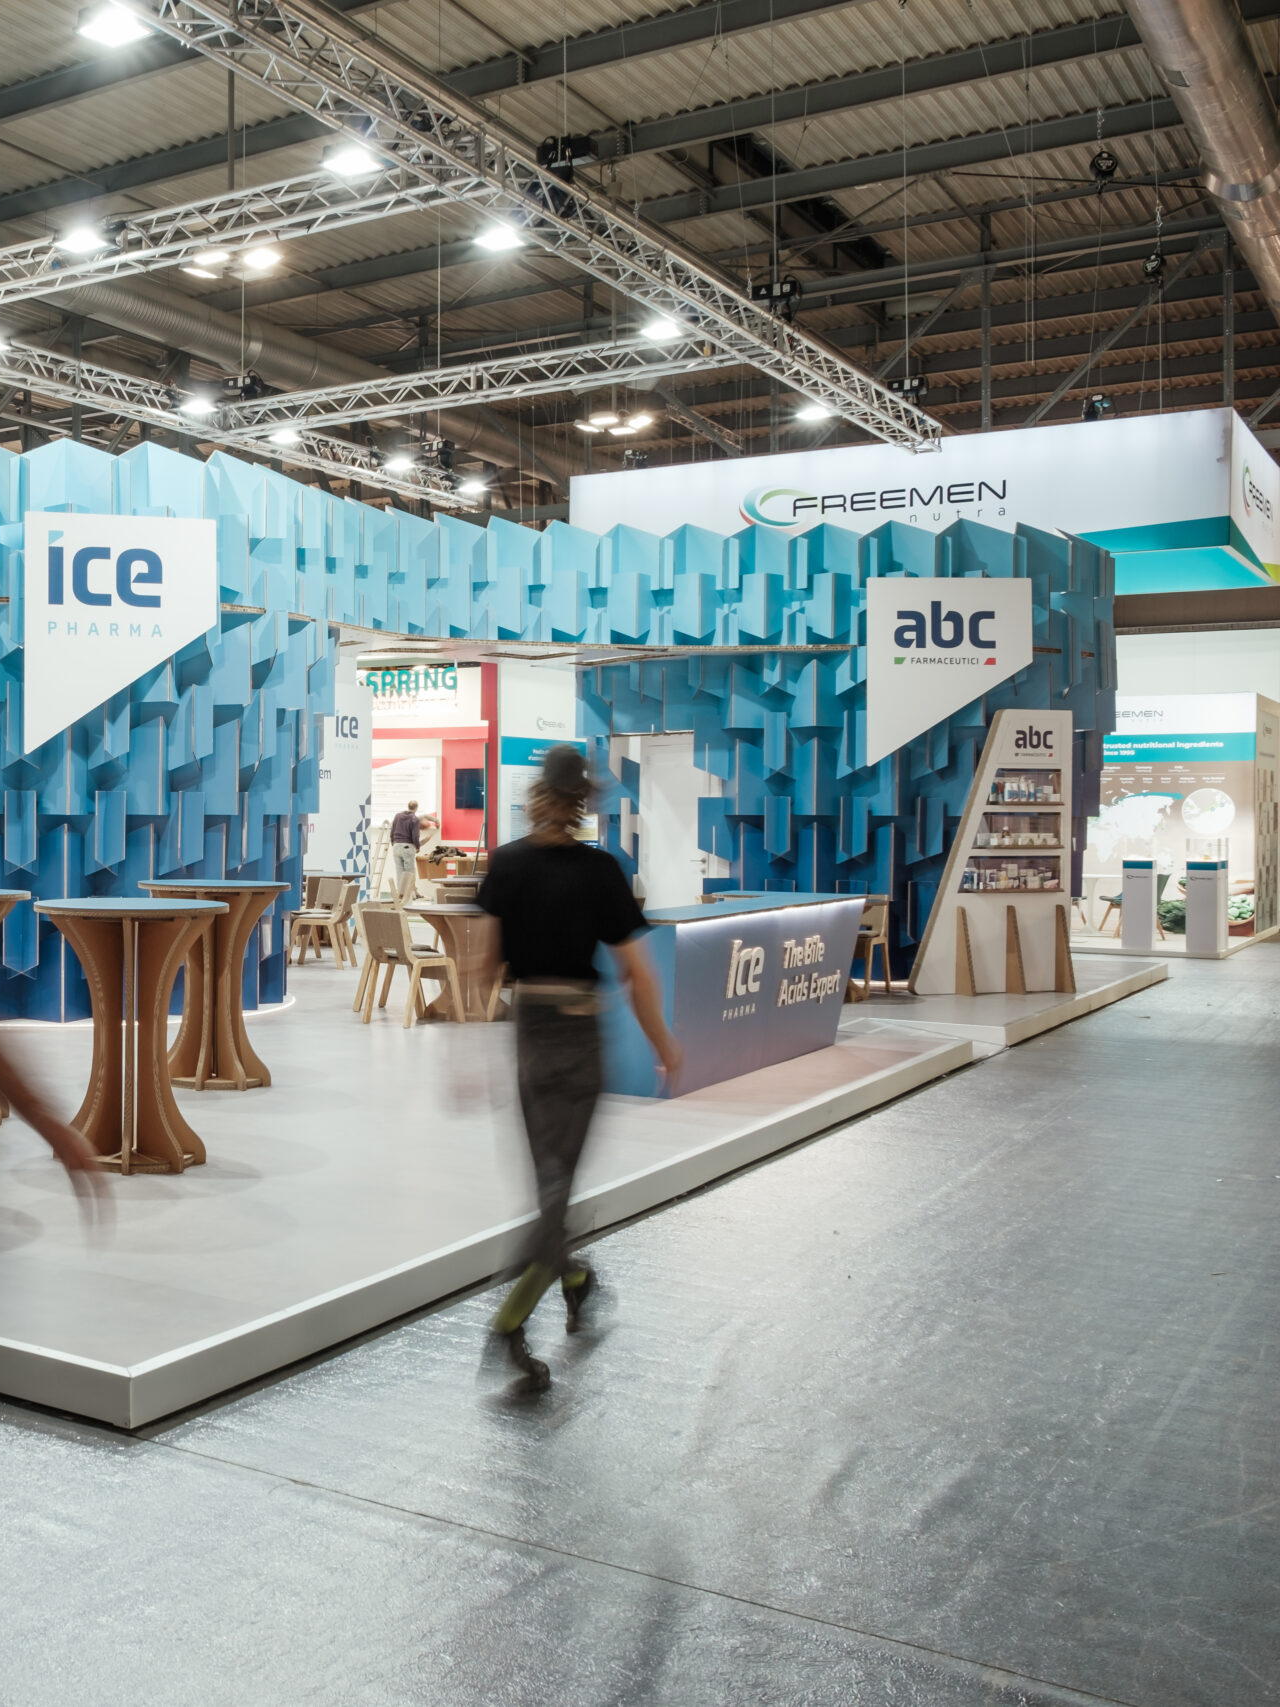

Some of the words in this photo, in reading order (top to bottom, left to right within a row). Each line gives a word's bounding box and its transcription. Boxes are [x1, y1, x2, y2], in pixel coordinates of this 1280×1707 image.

[792, 479, 1007, 517] FREEMEN
[909, 506, 1006, 523] nutra
[48, 529, 163, 608] ice
[47, 621, 163, 638] PHARMA
[894, 600, 997, 649] abc
[910, 657, 979, 665] FARMACEUTICI
[335, 709, 359, 739] ice
[1115, 710, 1164, 719] EEMEN
[1014, 725, 1054, 749] abc
[1133, 741, 1176, 749] nutritional
[1176, 740, 1225, 749] ingredients
[783, 939, 804, 969] The
[804, 934, 826, 965] Bile
[726, 939, 765, 999] ice
[776, 973, 809, 1008] Acids
[808, 969, 842, 1005] Expert
[722, 1003, 757, 1021] PHARMA
